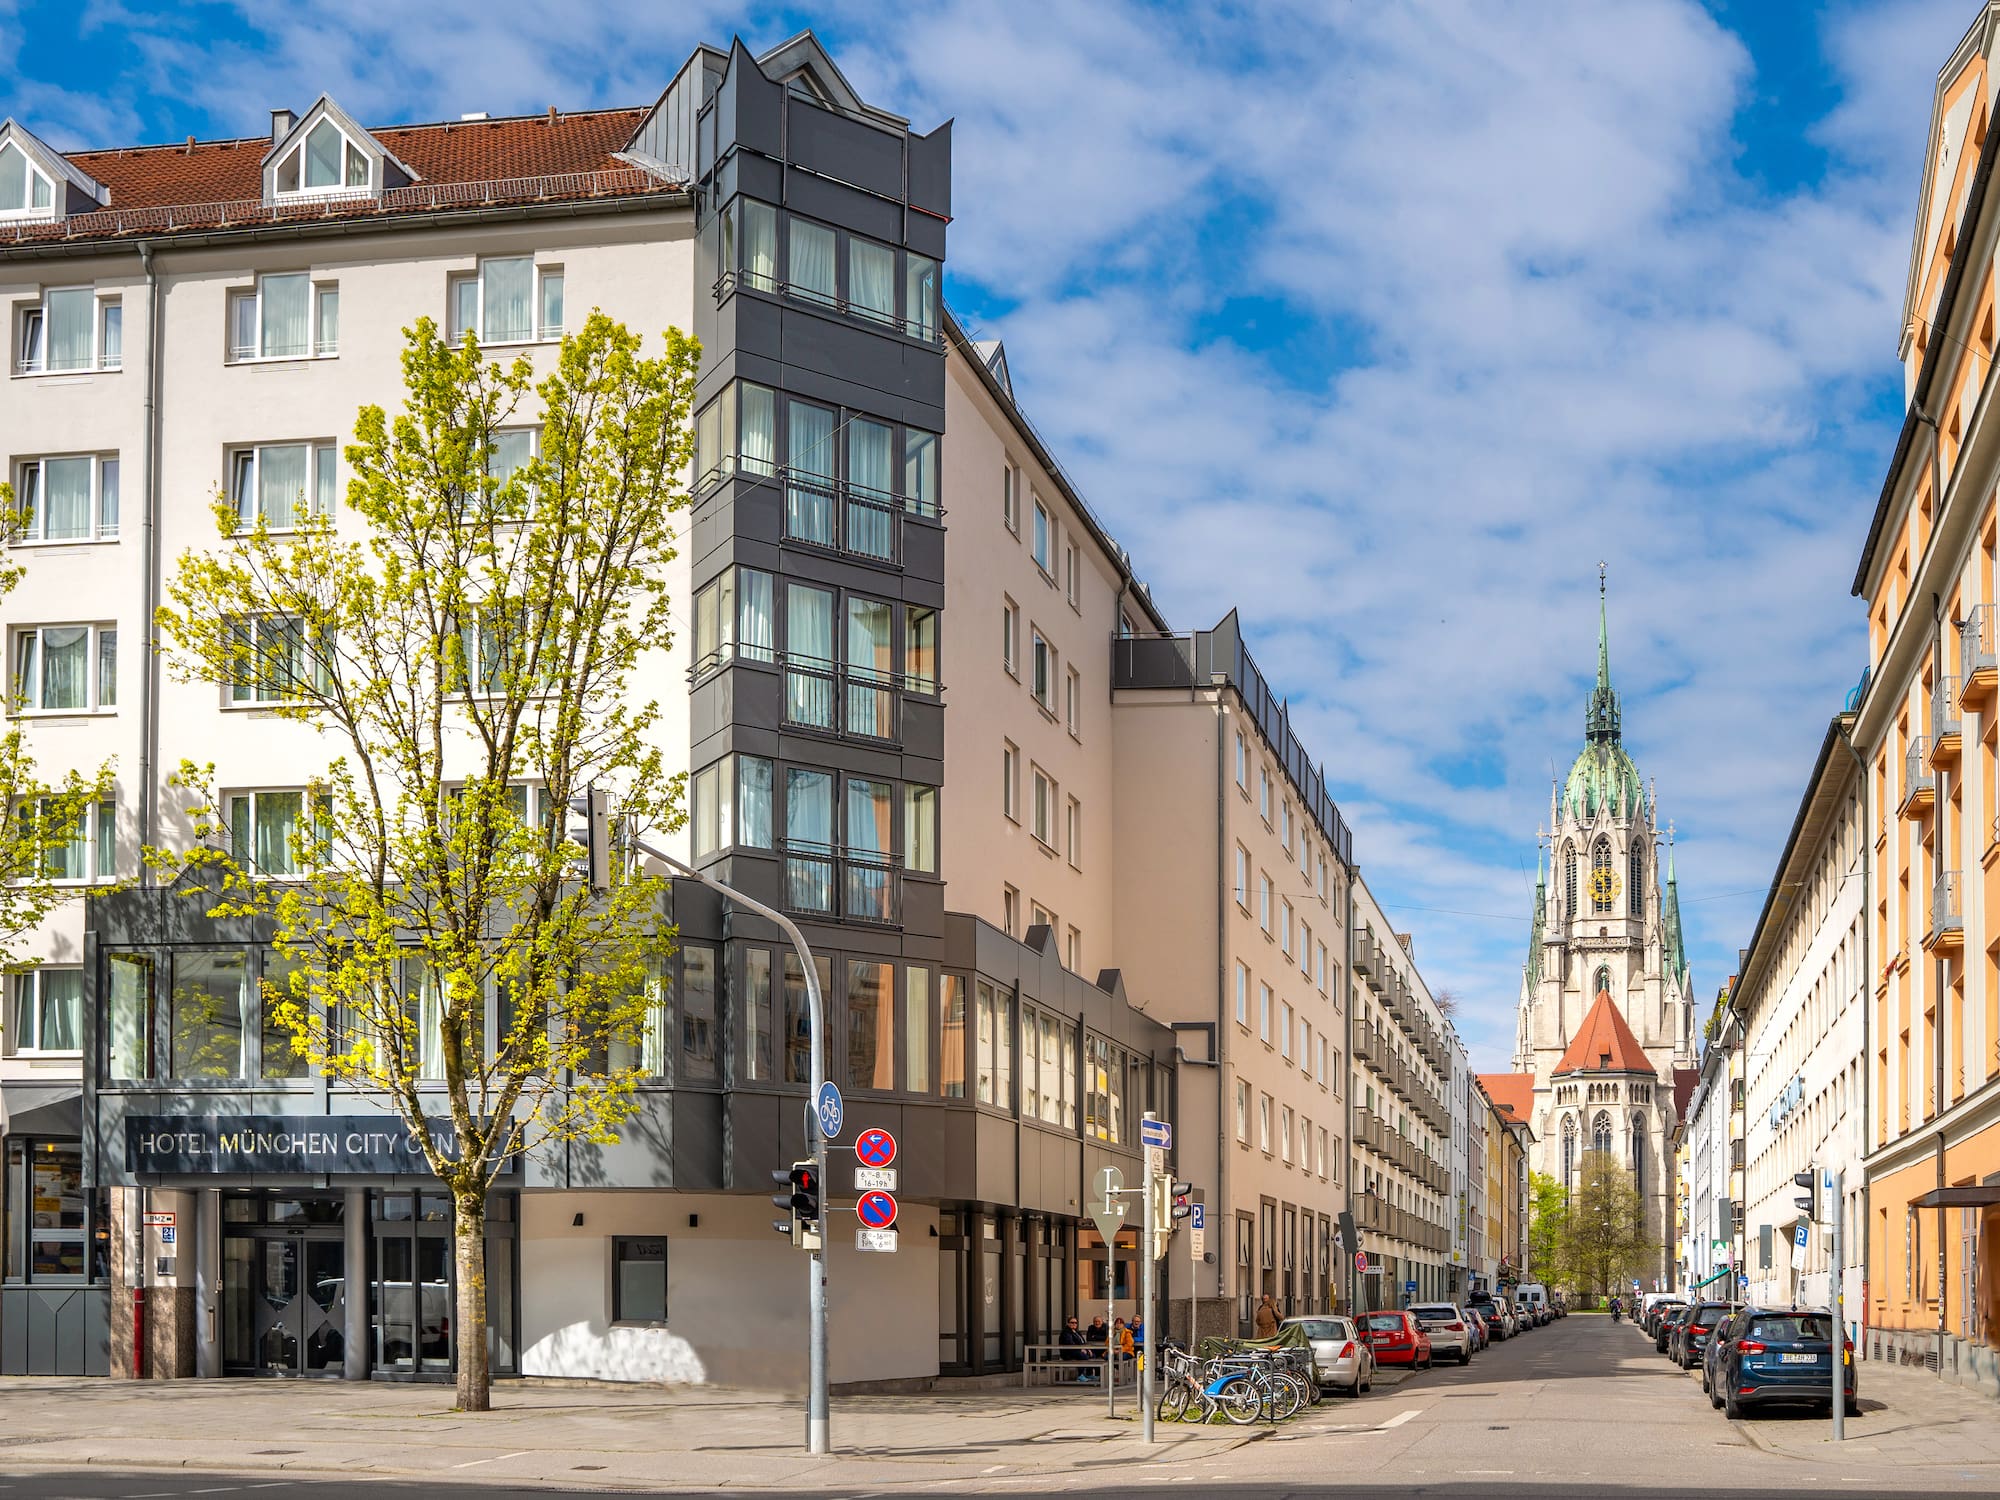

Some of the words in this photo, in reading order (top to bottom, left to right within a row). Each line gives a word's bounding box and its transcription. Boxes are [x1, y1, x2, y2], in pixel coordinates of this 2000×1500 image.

[140, 1133, 213, 1154] HOTEL
[219, 1129, 338, 1155] MÜNCHEN
[345, 1133, 398, 1154] CITY
